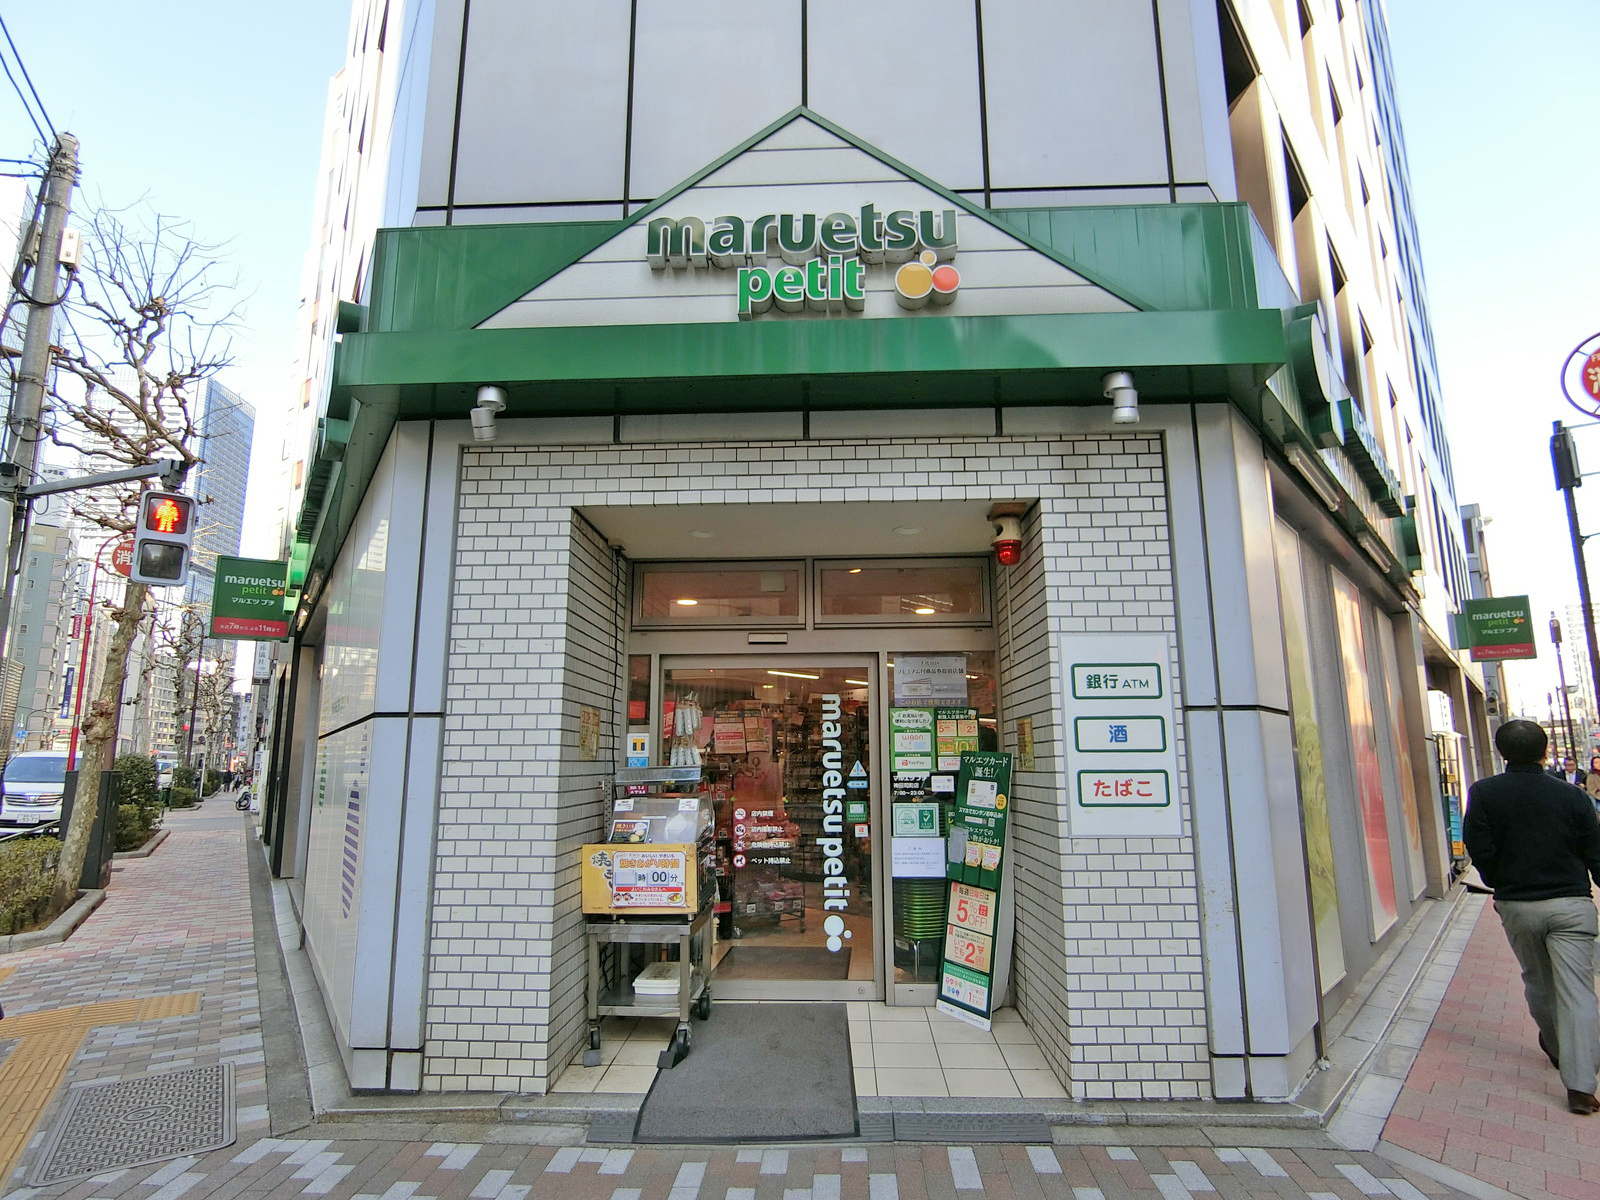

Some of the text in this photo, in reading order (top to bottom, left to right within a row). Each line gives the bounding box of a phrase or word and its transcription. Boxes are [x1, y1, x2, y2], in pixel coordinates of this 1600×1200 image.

[647, 203, 958, 262] maruetsu
[737, 254, 866, 315] petit
[224, 575, 285, 588] maruetsu
[241, 586, 267, 595] petit
[231, 596, 260, 605] マルエツ
[1472, 610, 1524, 620] maruetsu
[1487, 618, 1509, 627] petit
[1086, 674, 1150, 689] 銀行 ATM
[1108, 724, 1128, 743] 酒
[963, 756, 1009, 767] マルエツカード
[1093, 777, 1153, 797] たばこ
[816, 694, 850, 911] maruetsu petit
[620, 859, 680, 869] 焼きあがり時間
[751, 857, 792, 865] ペット持込禁止
[637, 873, 646, 882] 時
[652, 871, 667, 883] 00
[670, 873, 678, 883] 分
[958, 886, 990, 901] 毎週日曜日は
